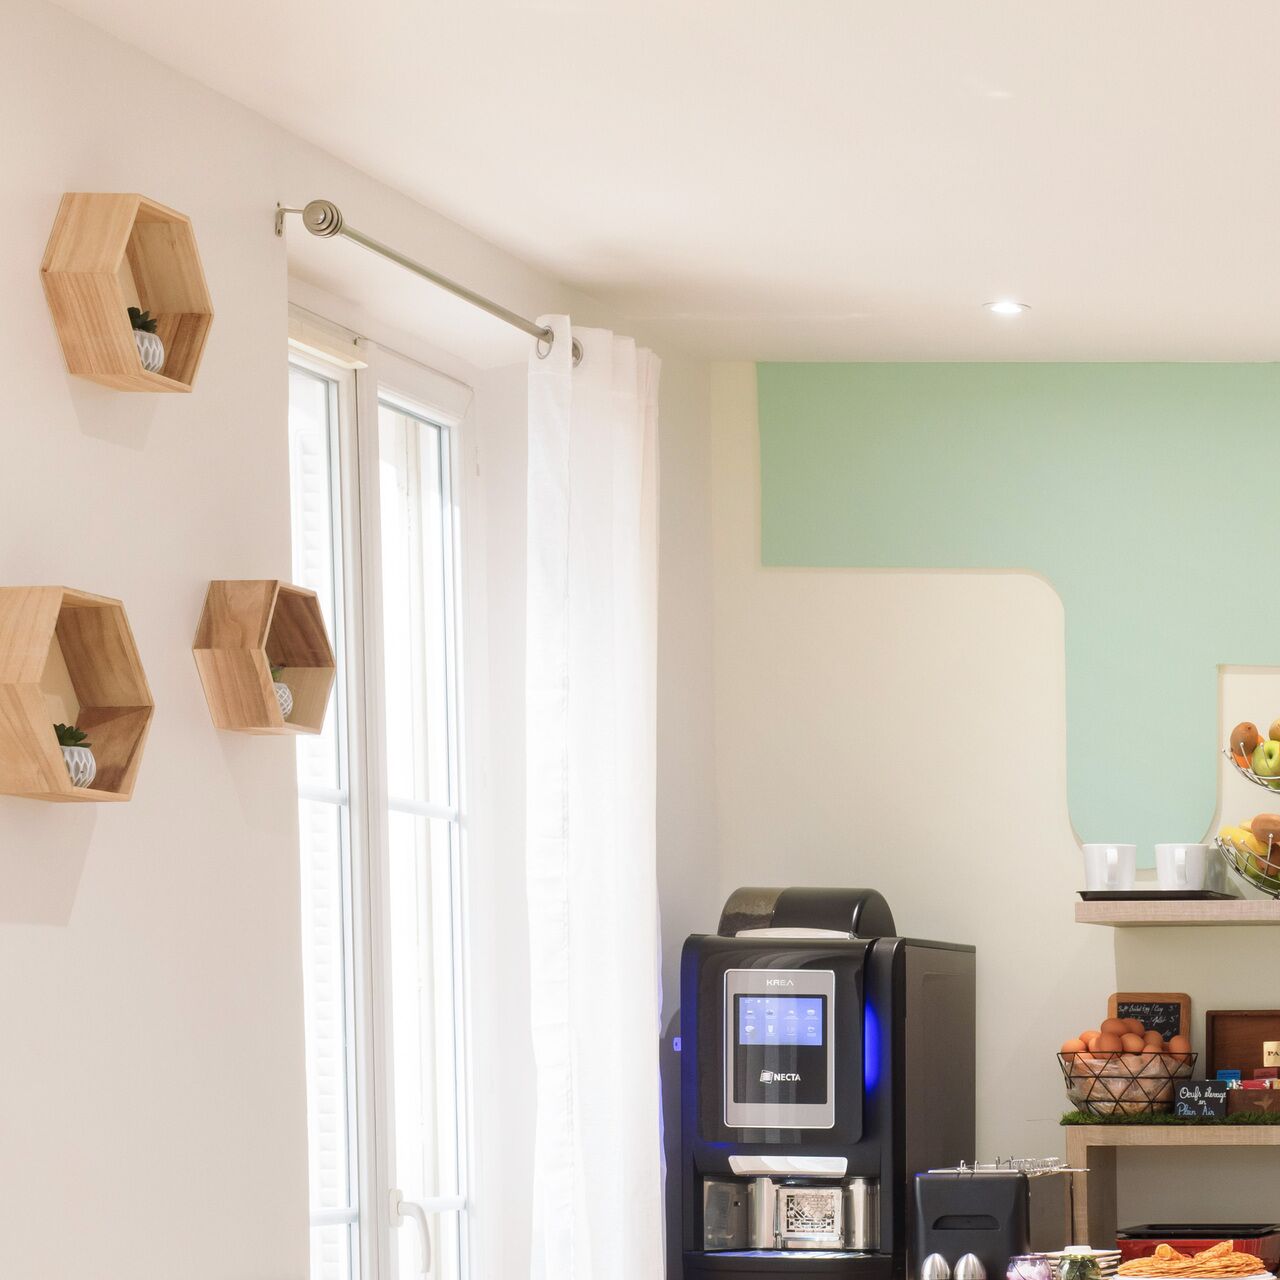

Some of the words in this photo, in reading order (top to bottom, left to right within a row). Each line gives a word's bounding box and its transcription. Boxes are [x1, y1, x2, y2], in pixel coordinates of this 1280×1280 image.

[766, 979, 794, 987] KREA
[773, 1073, 801, 1082] NECTA
[1201, 1104, 1215, 1116] Air
